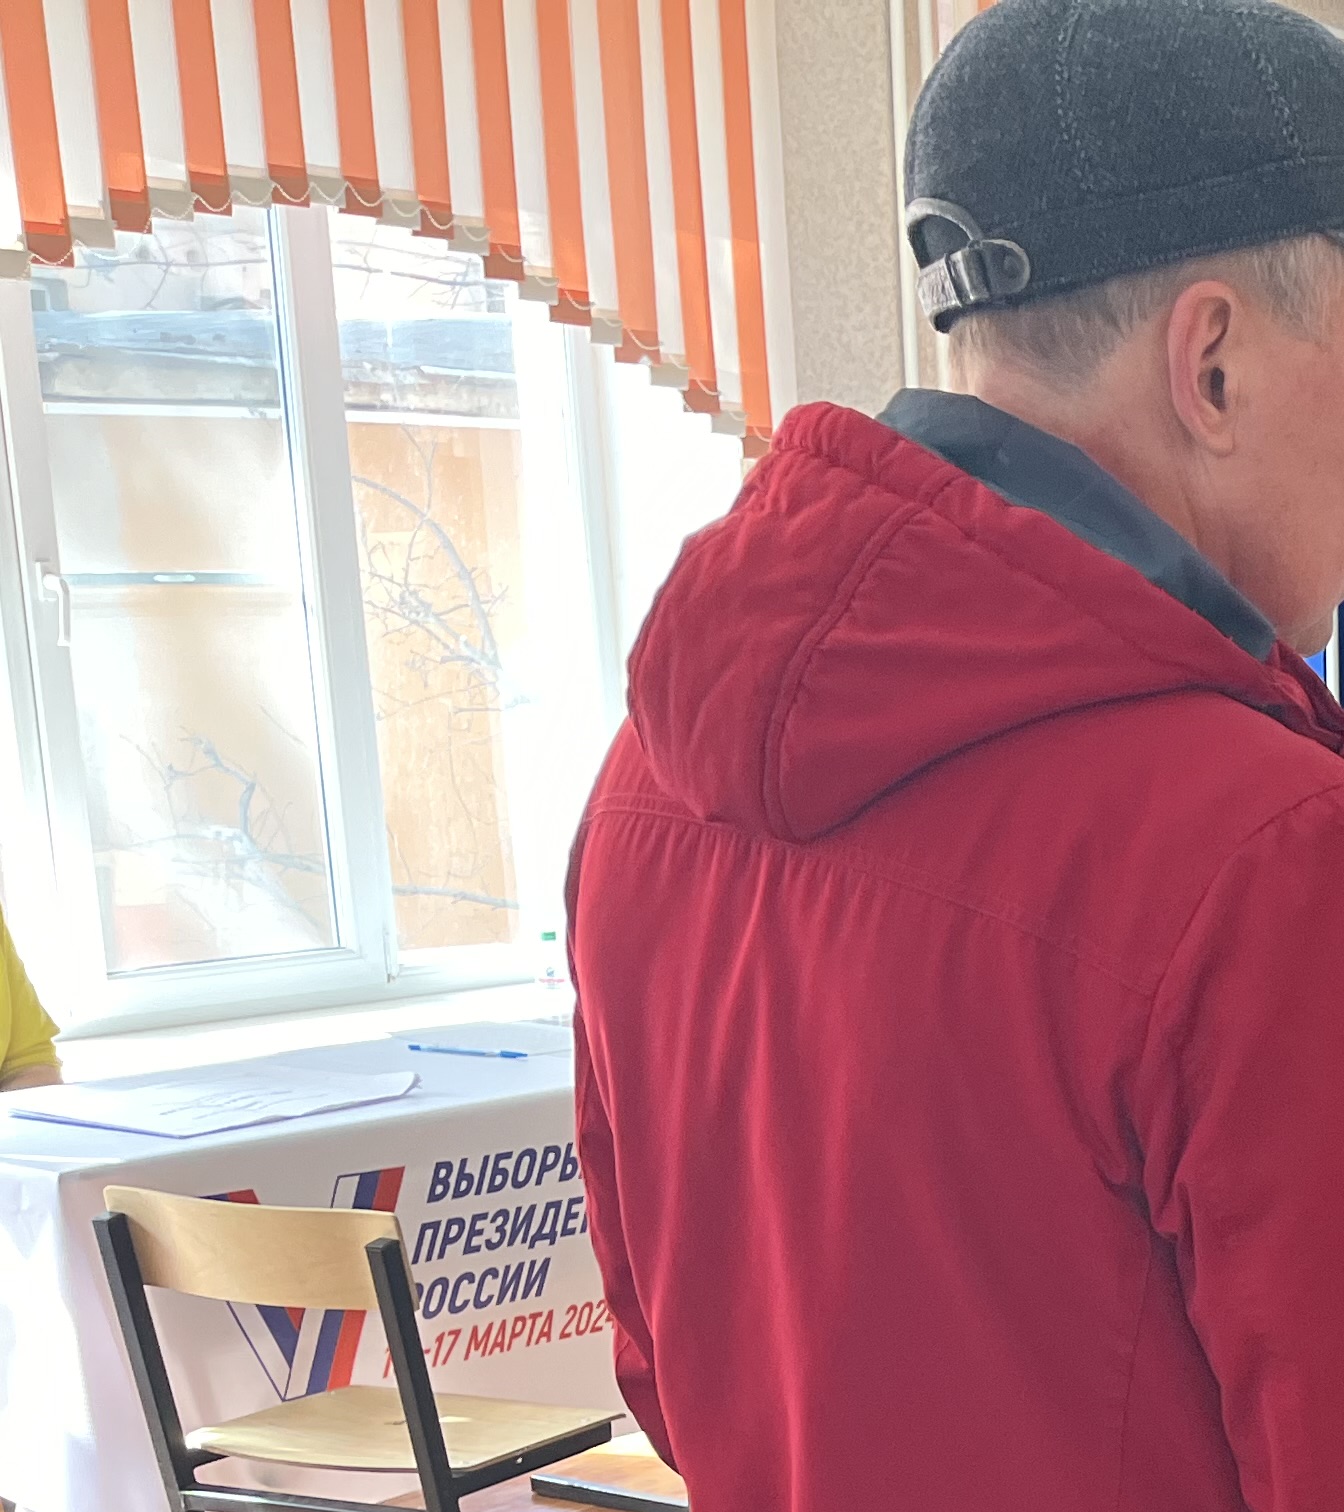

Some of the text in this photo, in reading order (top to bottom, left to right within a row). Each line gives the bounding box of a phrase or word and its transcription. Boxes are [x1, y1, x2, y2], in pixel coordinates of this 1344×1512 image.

[411, 1196, 588, 1266] ПРЕЗИДЕ
[383, 1329, 462, 1379] 1-17
[463, 1310, 554, 1361] МАРТА
